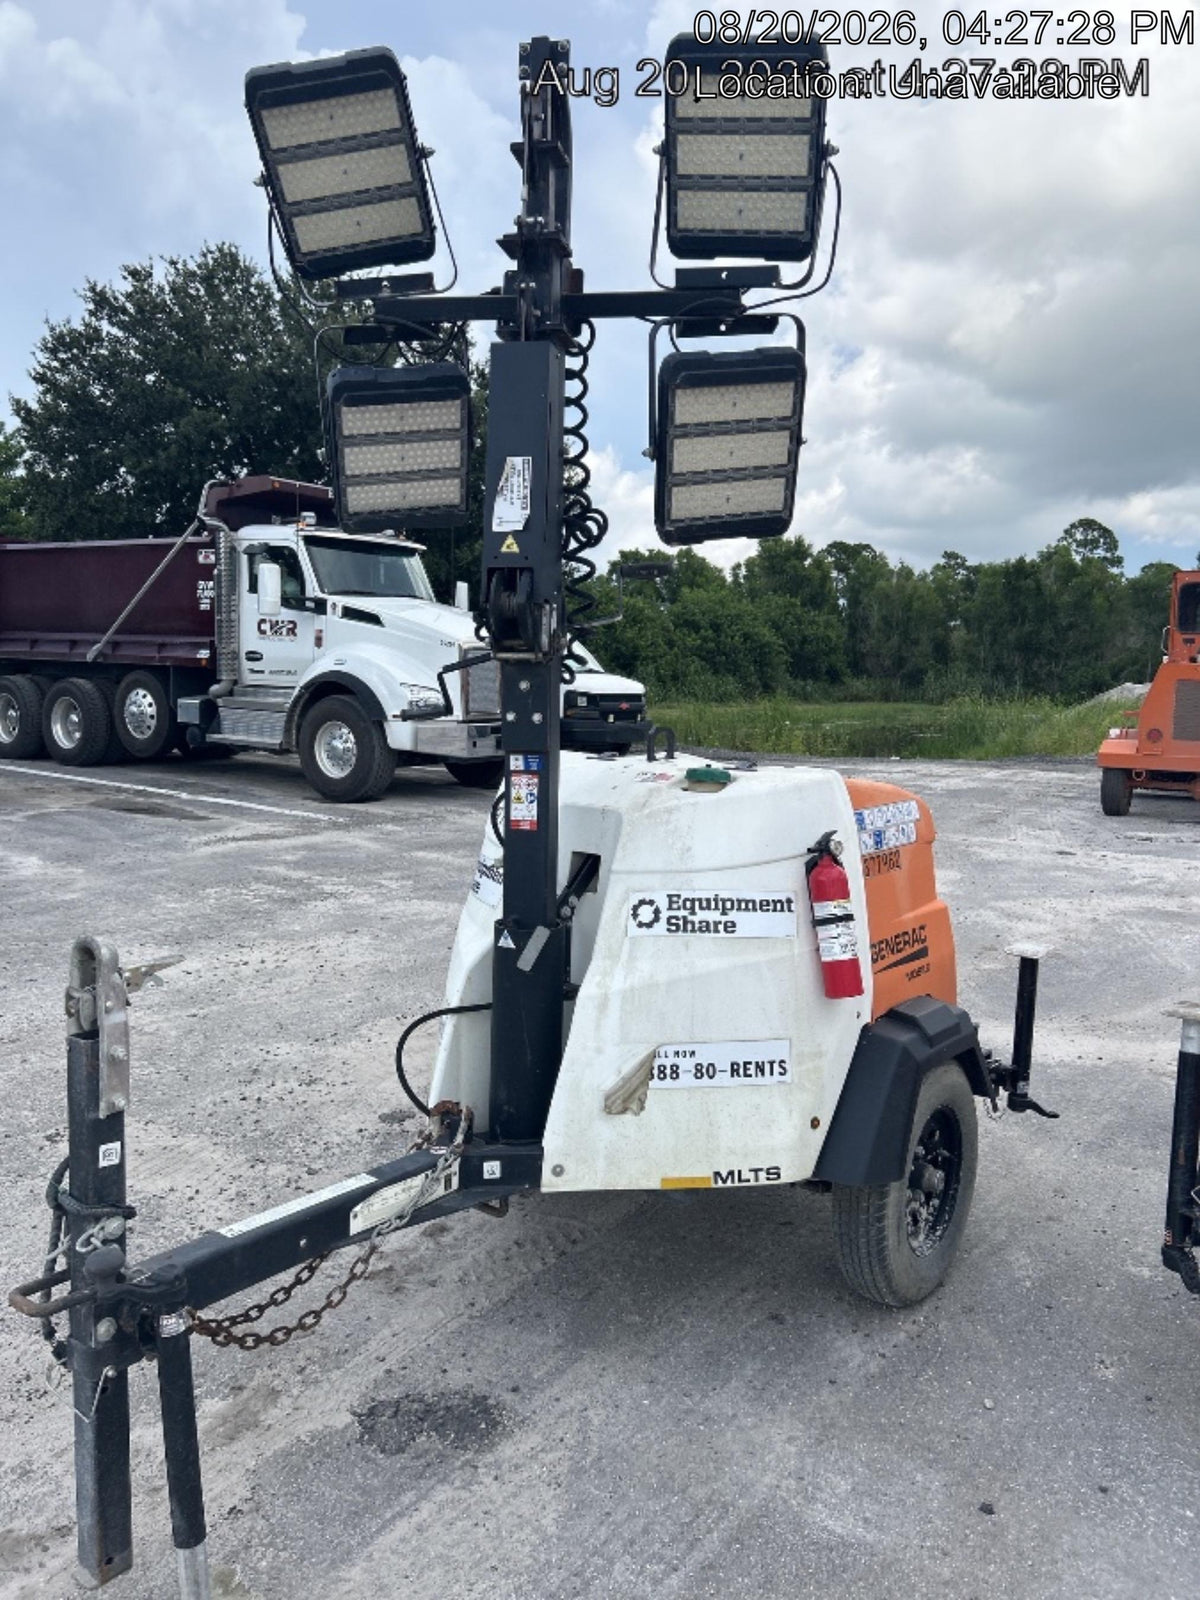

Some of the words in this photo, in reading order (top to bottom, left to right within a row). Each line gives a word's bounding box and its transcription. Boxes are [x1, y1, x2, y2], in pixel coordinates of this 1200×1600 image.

[666, 894, 794, 916] Equipment
[666, 915, 737, 934] Share
[870, 924, 927, 964] GENERAC
[673, 1050, 696, 1059] NOW
[713, 1166, 781, 1185] MLTS
